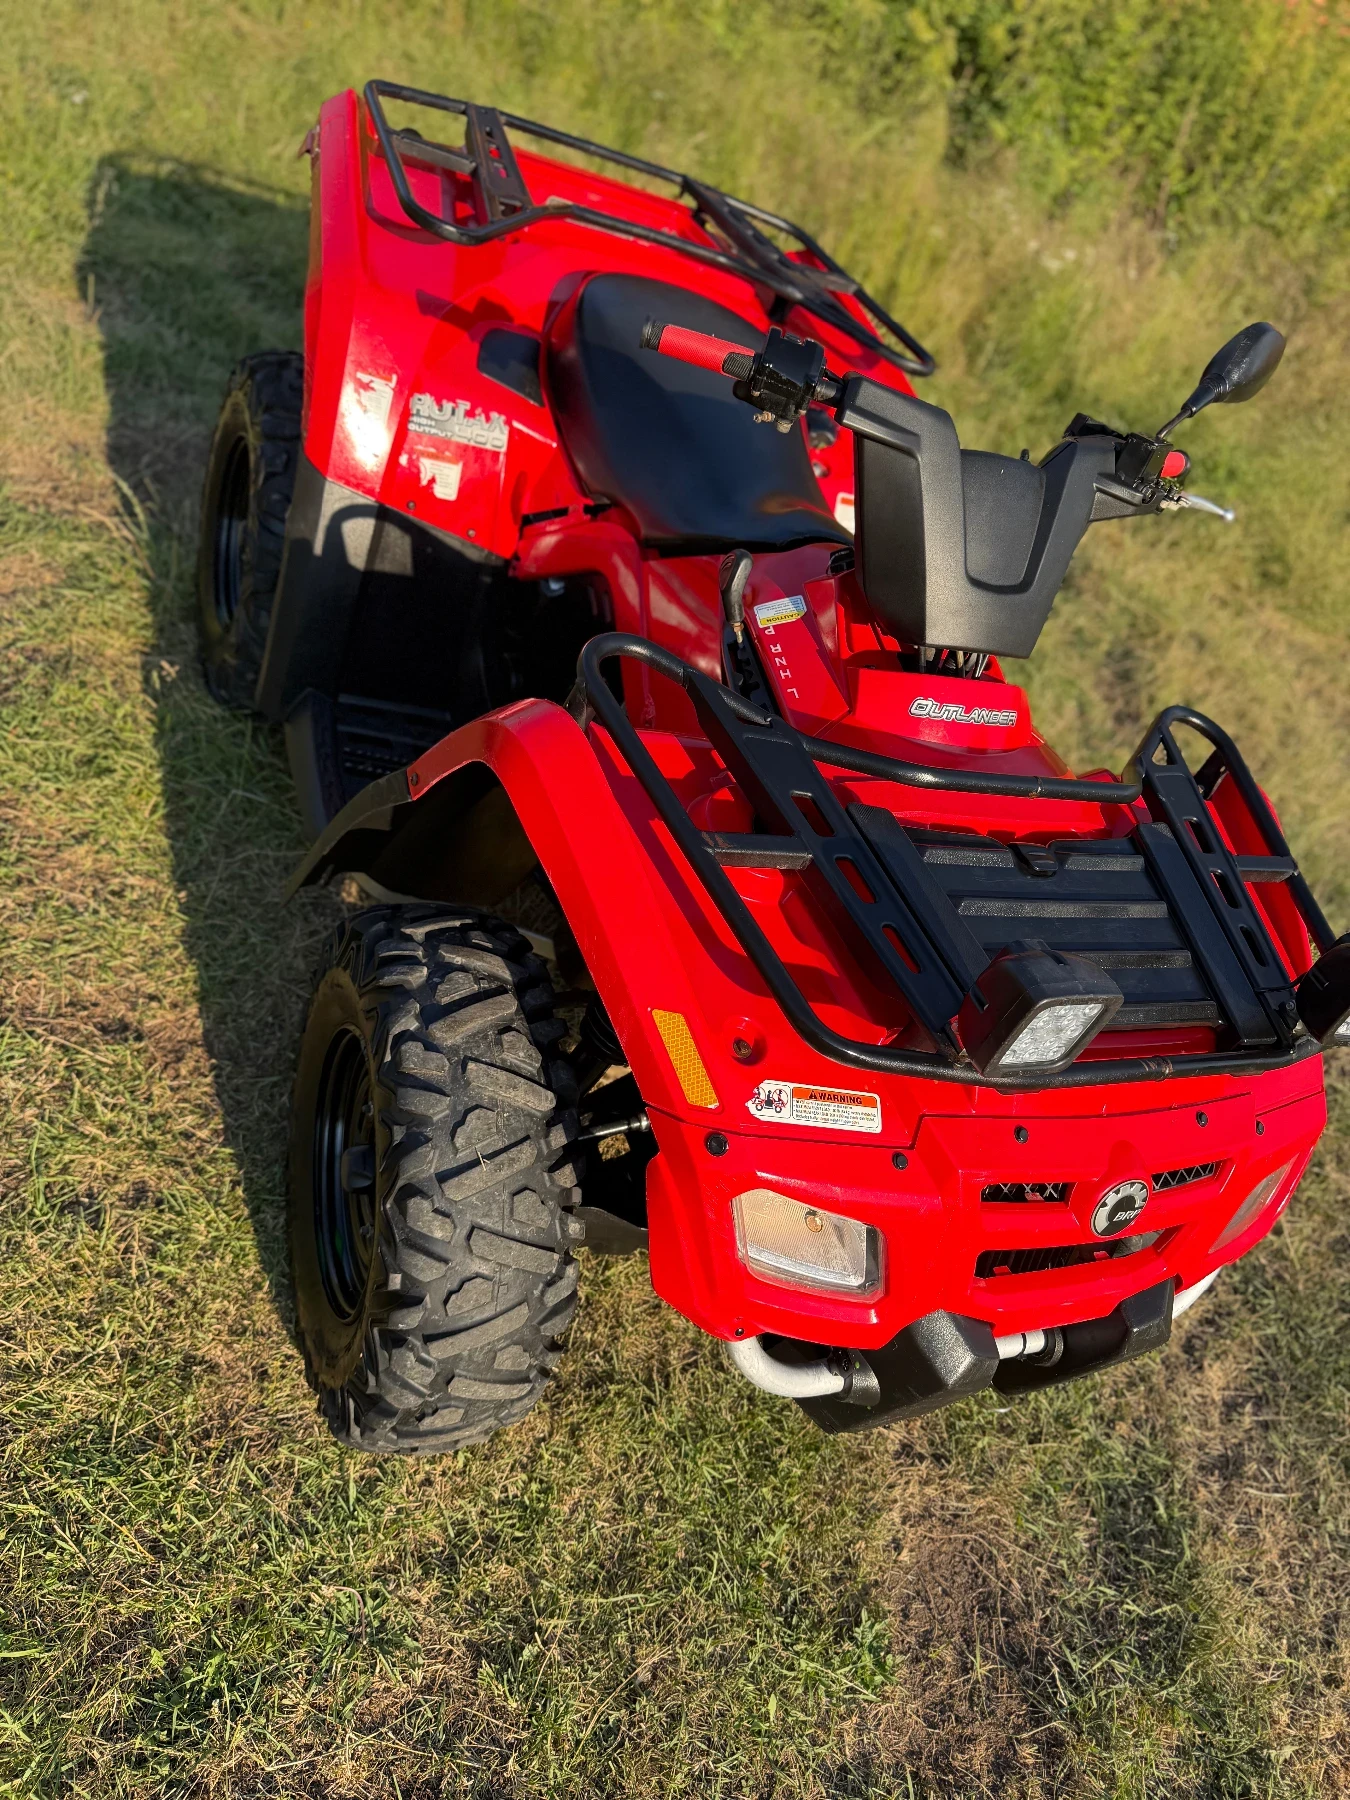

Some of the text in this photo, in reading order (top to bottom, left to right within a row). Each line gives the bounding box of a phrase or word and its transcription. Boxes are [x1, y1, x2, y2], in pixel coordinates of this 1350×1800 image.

[407, 422, 454, 438] OUTPUT
[456, 425, 505, 450] 400
[766, 613, 800, 623] CAUTION
[765, 626, 799, 698] P R N H L
[908, 697, 1017, 727] OUTLANDER
[818, 1091, 862, 1104] WARNING
[1113, 1209, 1141, 1221] BRP
